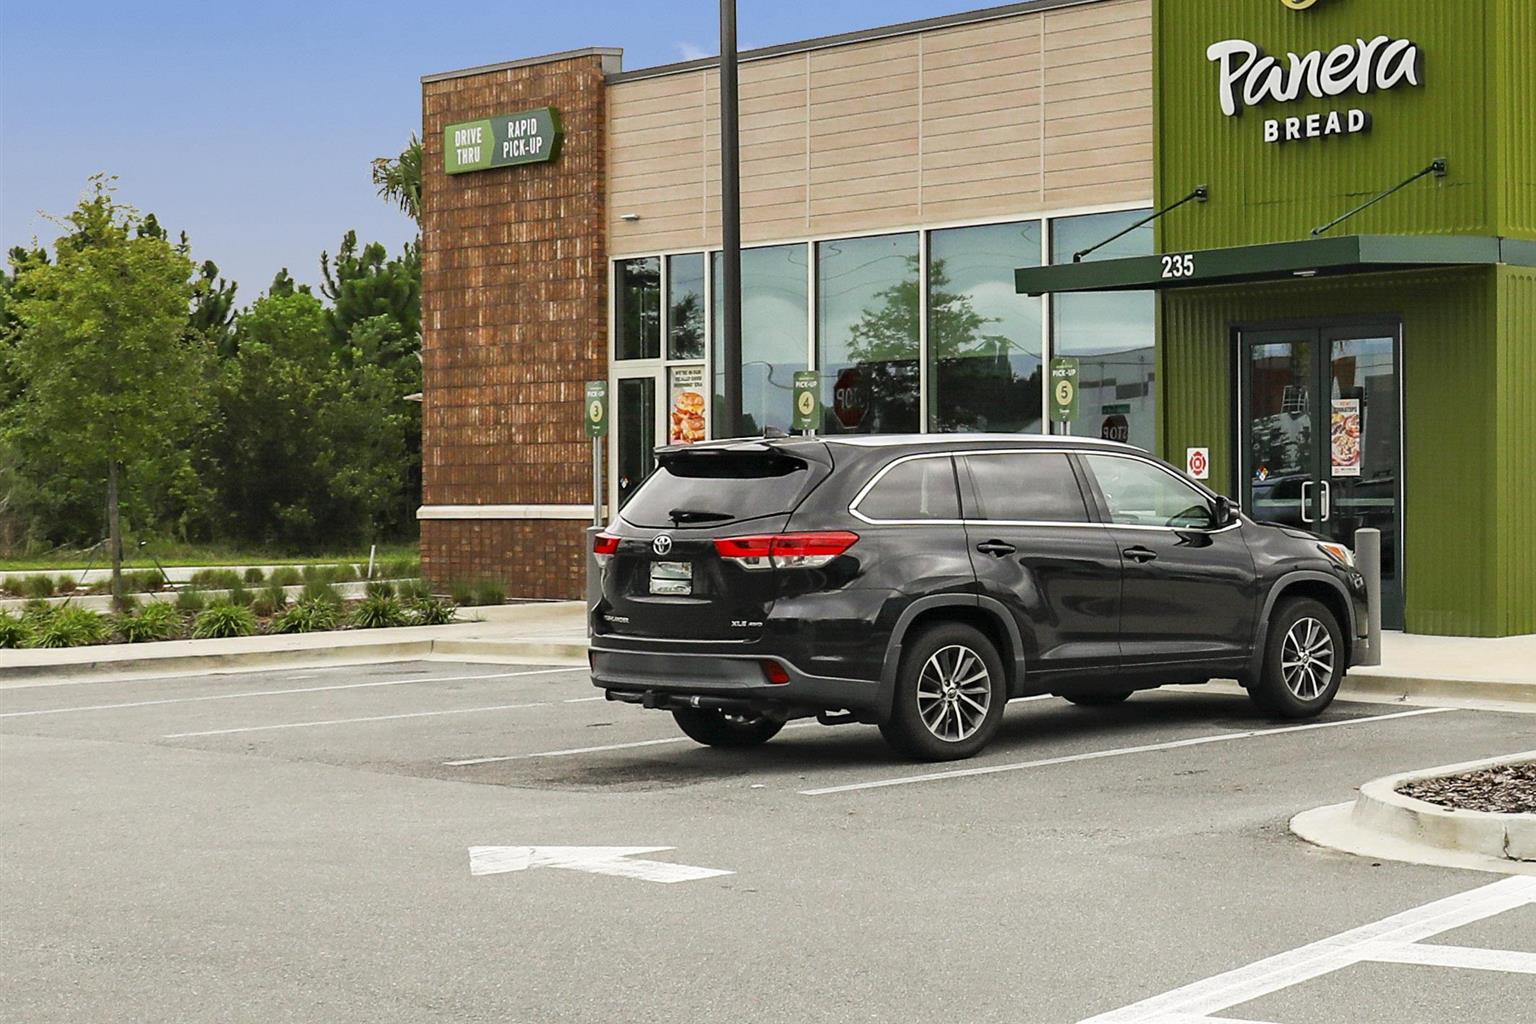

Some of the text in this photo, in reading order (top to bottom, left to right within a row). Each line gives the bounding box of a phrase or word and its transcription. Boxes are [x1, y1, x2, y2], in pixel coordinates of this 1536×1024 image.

[1206, 35, 1418, 117] Panera
[508, 118, 537, 138] RAPID
[1264, 108, 1365, 143] BREAD
[455, 127, 482, 146] DRIVE
[457, 146, 480, 165] THRU
[503, 136, 542, 158] PICK-UP
[1161, 254, 1195, 278] 235
[1061, 386, 1068, 399] 5
[594, 405, 600, 417] 3
[802, 397, 810, 409] 4
